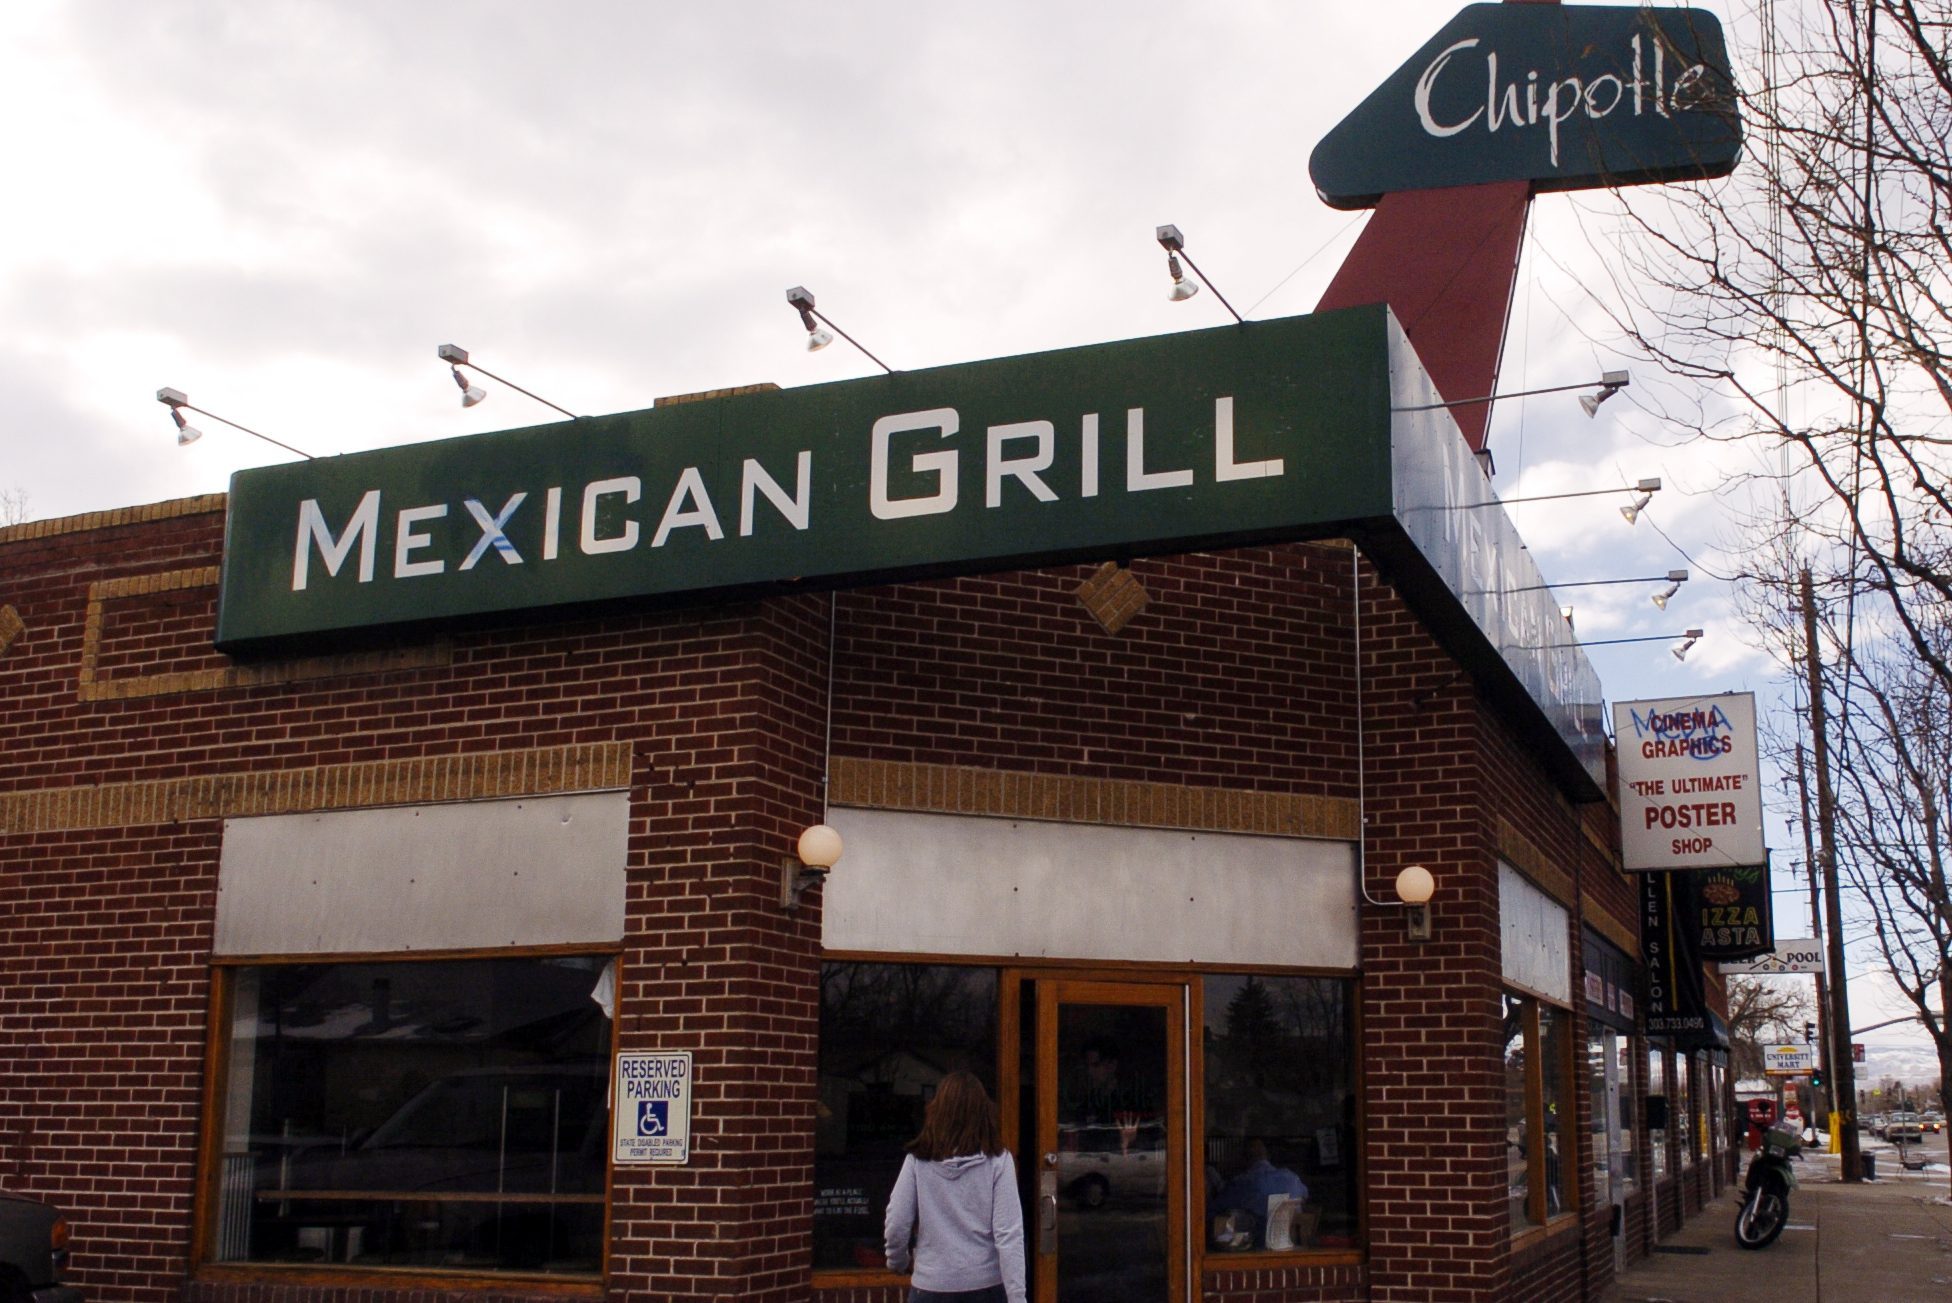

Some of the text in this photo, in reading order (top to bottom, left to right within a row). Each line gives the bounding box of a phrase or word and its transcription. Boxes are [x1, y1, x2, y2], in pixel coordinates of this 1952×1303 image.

[1415, 33, 1708, 167] Chipotle
[292, 397, 1284, 591] MEXICAN GRILL
[1651, 711, 1719, 732] CINEMA
[1642, 735, 1732, 759] GRAPHICS
[1645, 802, 1736, 830] POSTER
[1672, 838, 1713, 855] SHOP
[1702, 906, 1759, 926] IZZA
[1700, 927, 1761, 946] ASTA
[1786, 952, 1821, 963] POOL
[1649, 942, 1663, 1013] SALON
[1766, 1053, 1809, 1061] UNIVERSITY
[1777, 1061, 1800, 1069] MART
[622, 1059, 686, 1079] RESERVED
[627, 1080, 681, 1099] PARKING
[662, 1138, 683, 1147] PARKING
